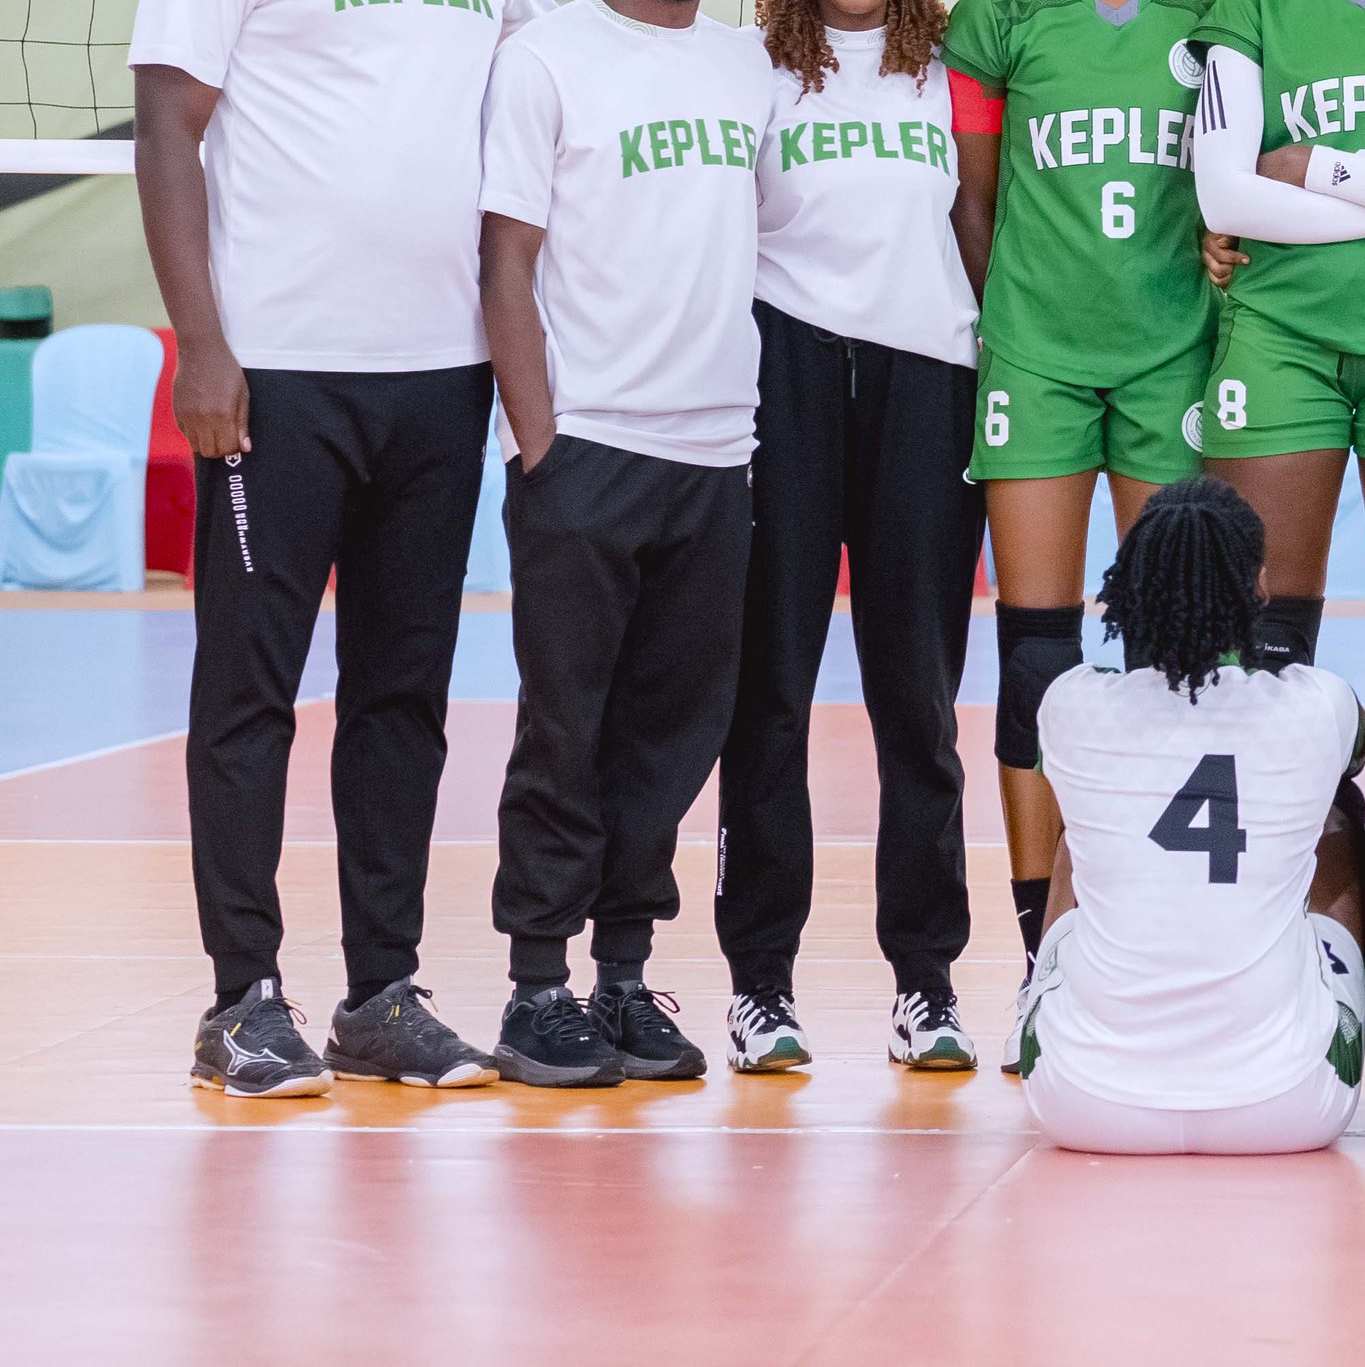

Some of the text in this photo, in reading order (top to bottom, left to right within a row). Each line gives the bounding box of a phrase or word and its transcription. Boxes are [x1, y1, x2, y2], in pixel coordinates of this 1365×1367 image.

[779, 120, 949, 175] KEPLER
[1100, 180, 1136, 239] 6
[984, 390, 1010, 447] 6
[1217, 379, 1248, 431] 8
[1148, 754, 1248, 885] 4
